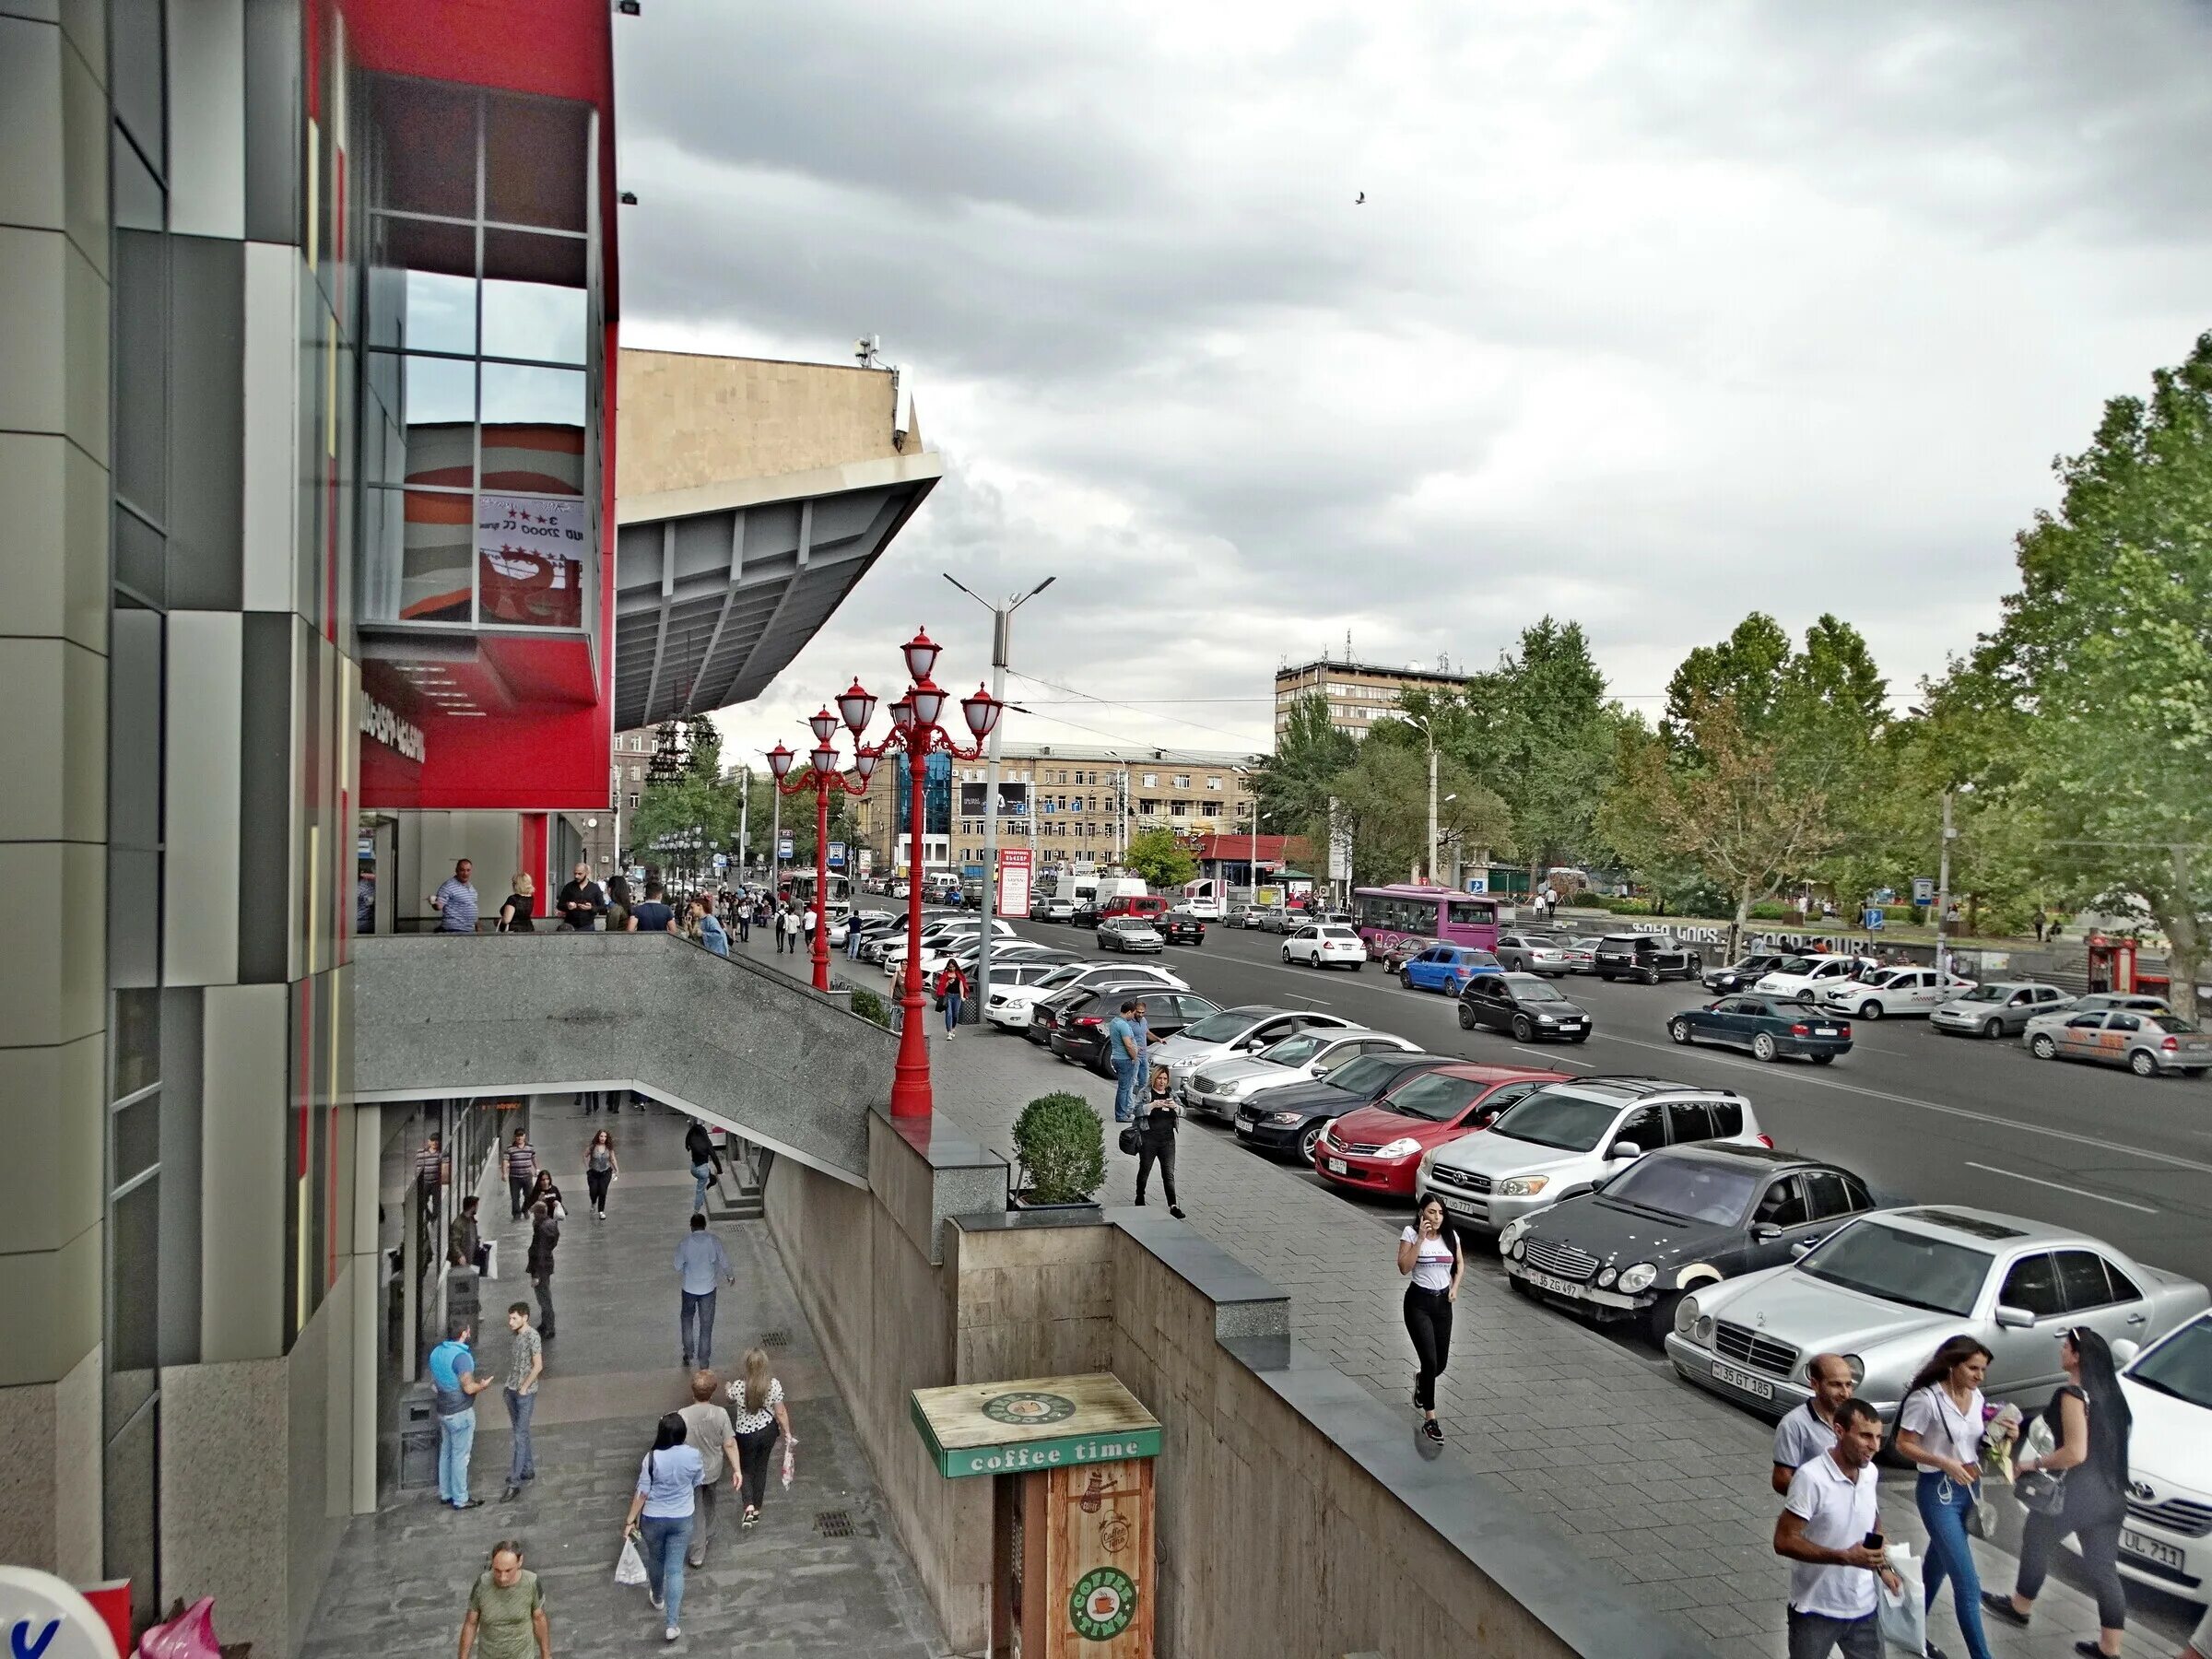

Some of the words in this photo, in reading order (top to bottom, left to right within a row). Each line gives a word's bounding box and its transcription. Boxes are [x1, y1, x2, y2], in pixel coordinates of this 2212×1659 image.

[1458, 1201, 1471, 1211] 777
[1539, 1276, 1548, 1287] 35
[1549, 1279, 1560, 1290] ZG
[1562, 1283, 1576, 1296] 497
[1723, 1368, 1734, 1382] 35
[1735, 1373, 1749, 1388] GT
[1751, 1380, 1769, 1395] 185
[971, 1448, 1061, 1471] coffee
[1075, 1441, 1139, 1460] time
[2124, 1532, 2145, 1553] UL
[2150, 1541, 2177, 1565] 711
[1074, 1571, 1133, 1608] COFFEE
[1079, 1611, 1127, 1637] TIME
